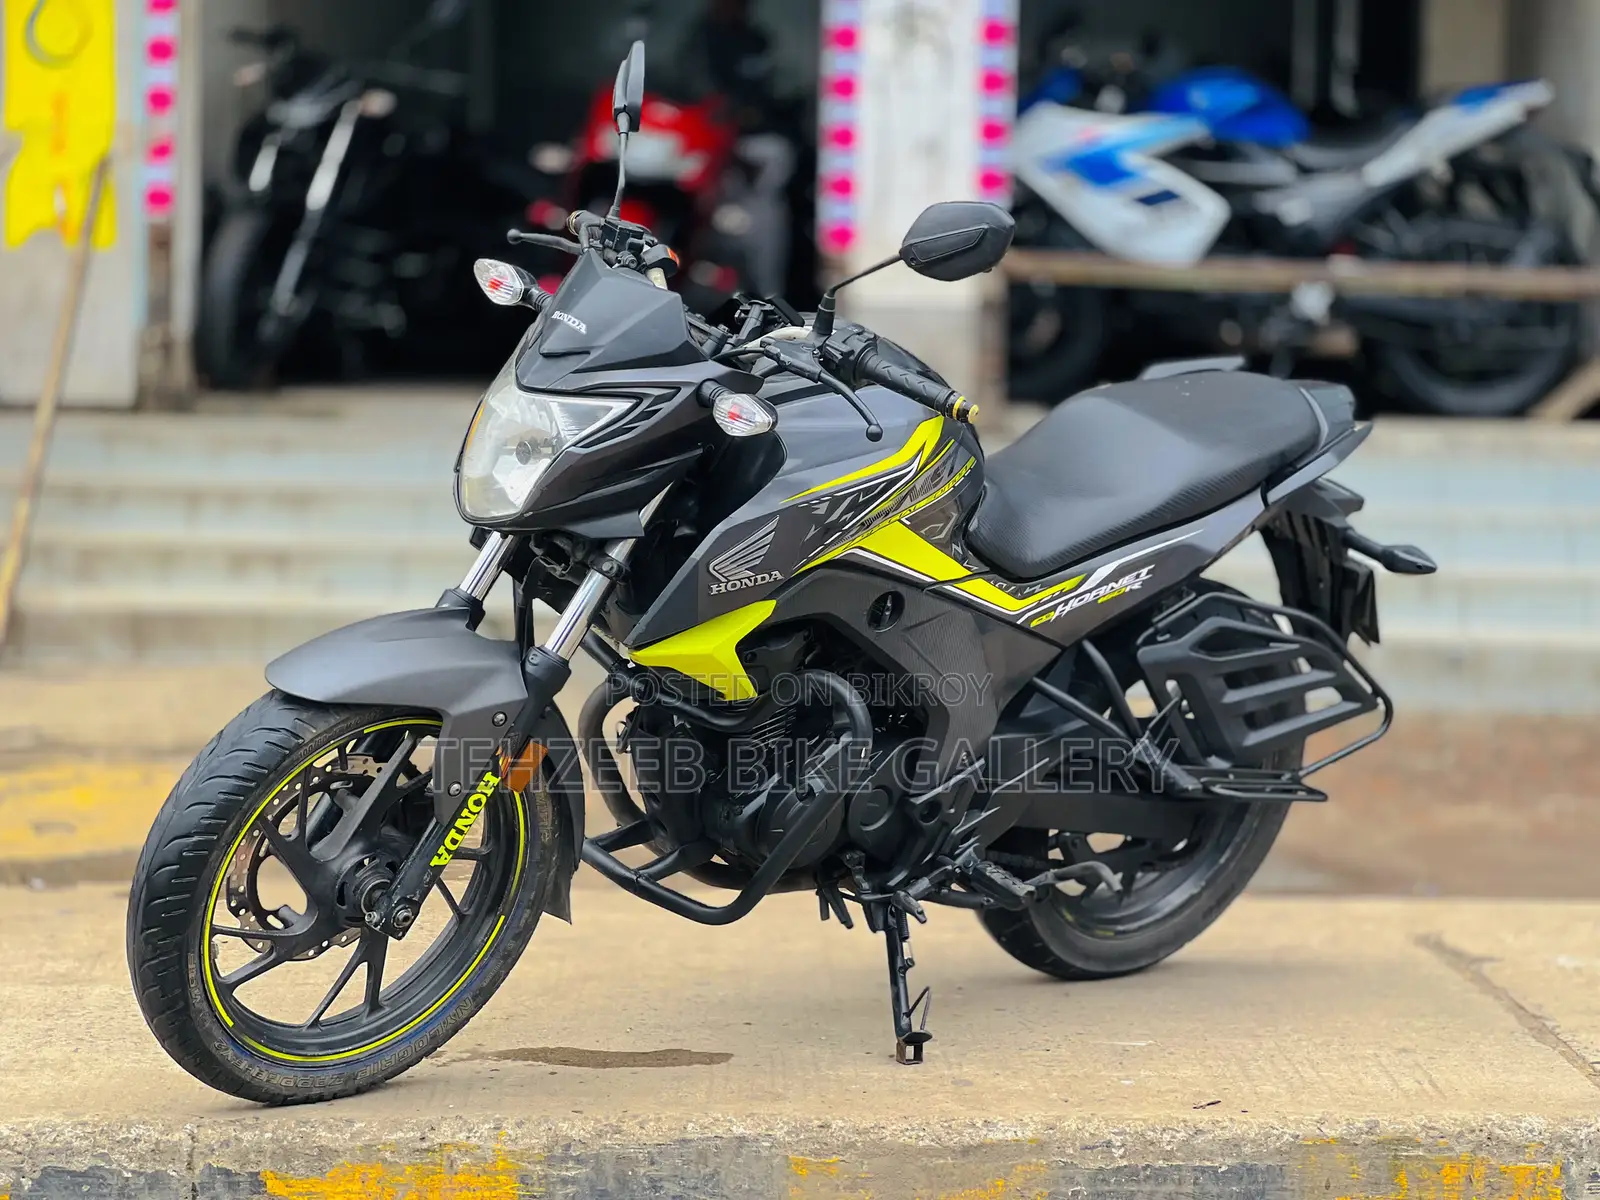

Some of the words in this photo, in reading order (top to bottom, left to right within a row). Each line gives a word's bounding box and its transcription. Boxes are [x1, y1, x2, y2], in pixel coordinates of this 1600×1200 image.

[551, 310, 587, 335] HONDA
[709, 570, 785, 596] HONDA
[1050, 564, 1156, 622] HORNET
[429, 771, 501, 867] HONDA
